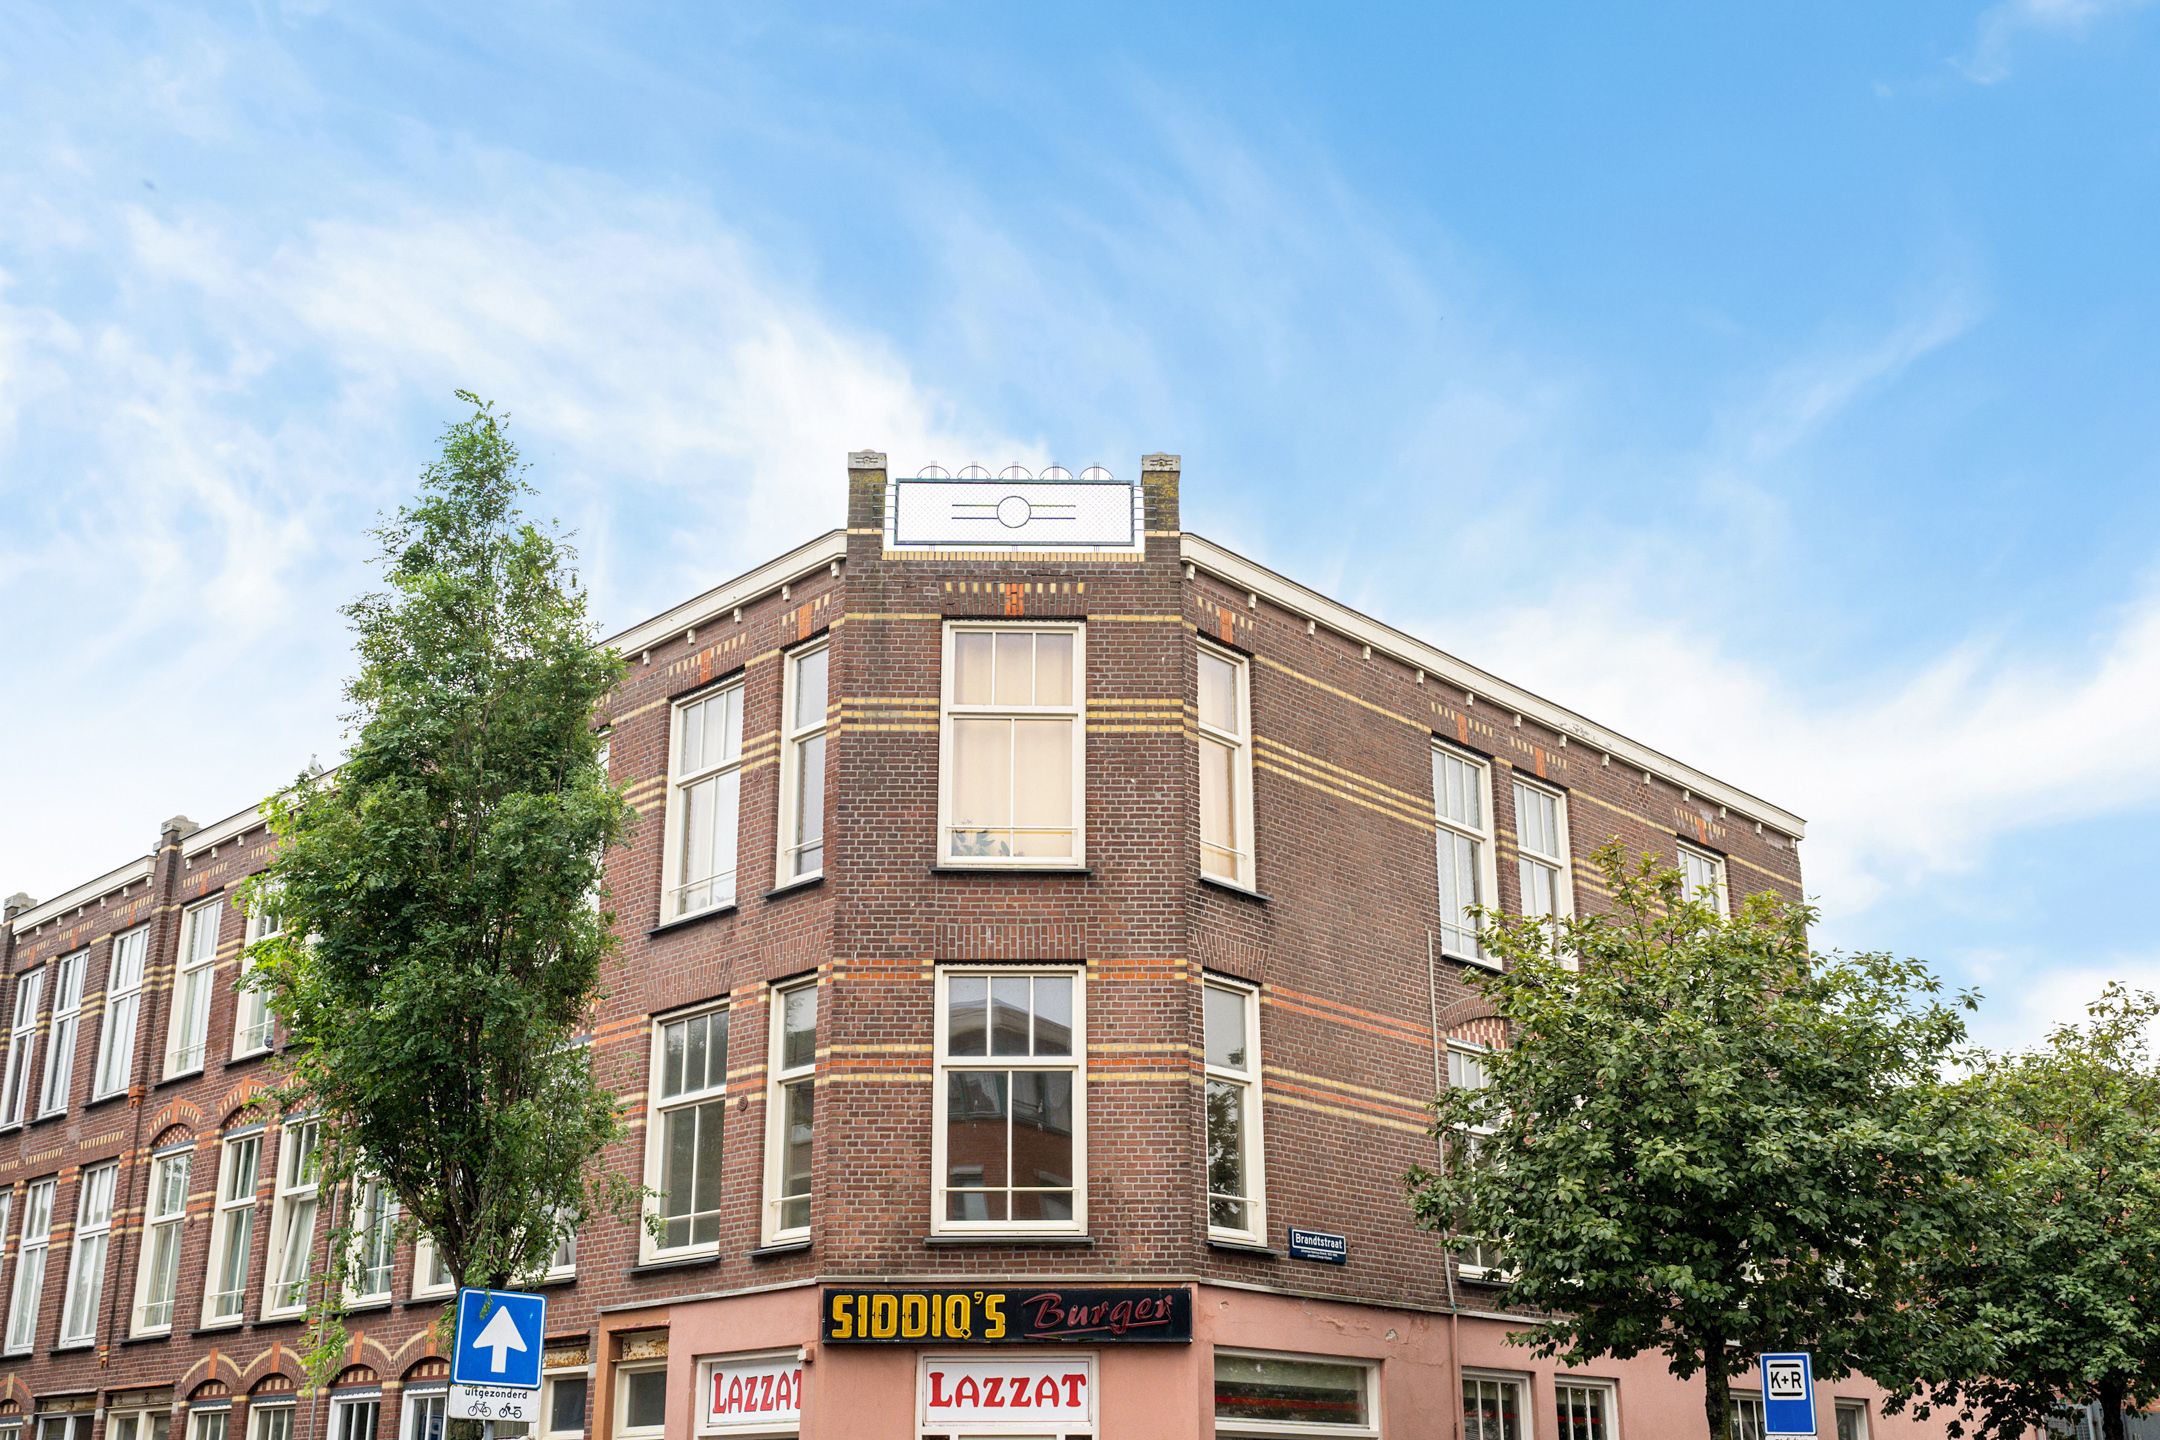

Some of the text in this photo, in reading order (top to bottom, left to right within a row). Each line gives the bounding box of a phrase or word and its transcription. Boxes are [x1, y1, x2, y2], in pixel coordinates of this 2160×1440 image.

[1295, 1233, 1343, 1249] Brandtstraat
[832, 1291, 1173, 1340] SIDDIQ'S Burger
[1770, 1371, 1802, 1389] K+R
[464, 1387, 528, 1400] uitgezonderd
[928, 1371, 1087, 1408] LAZZAT
